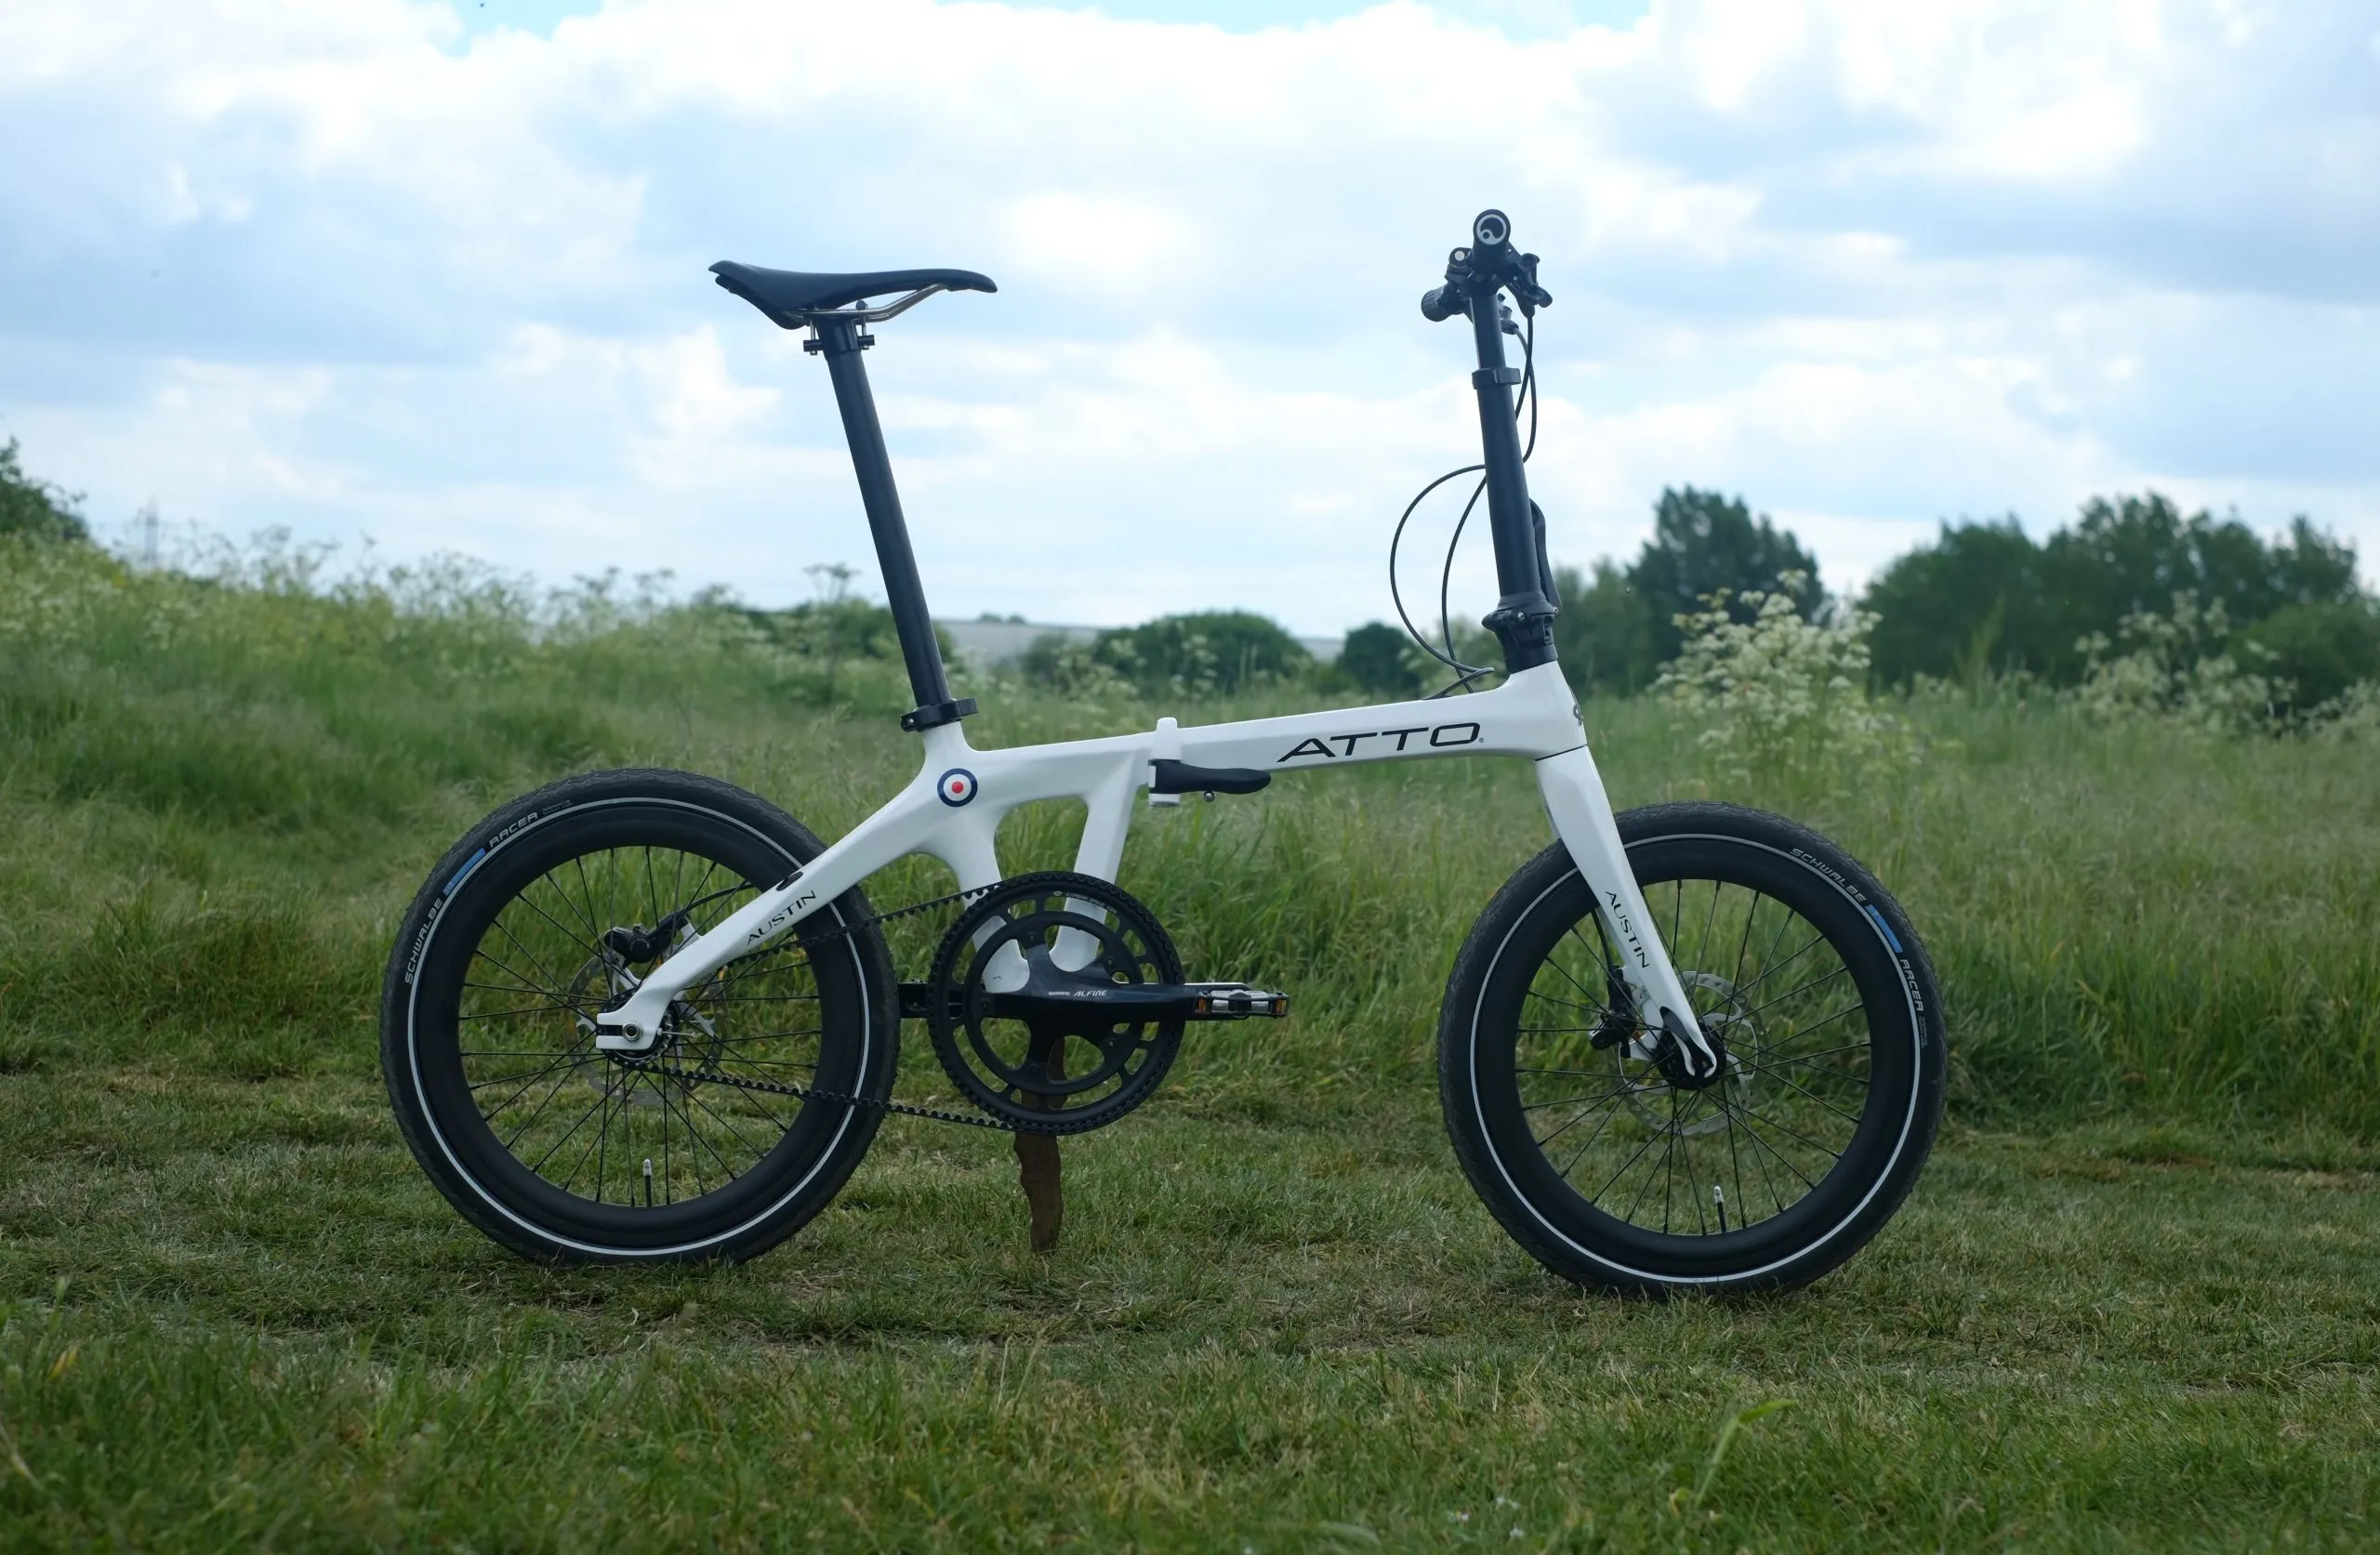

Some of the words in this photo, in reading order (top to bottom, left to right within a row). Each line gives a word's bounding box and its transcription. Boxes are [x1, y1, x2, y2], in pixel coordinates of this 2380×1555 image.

[404, 898, 443, 985] SCHWALBE
[489, 811, 538, 848] RACER
[747, 890, 816, 946] AUSTIN
[1605, 890, 1649, 968] AUSTIN
[1790, 848, 1867, 903] SCHWALBE
[1899, 958, 1924, 1012] RACER
